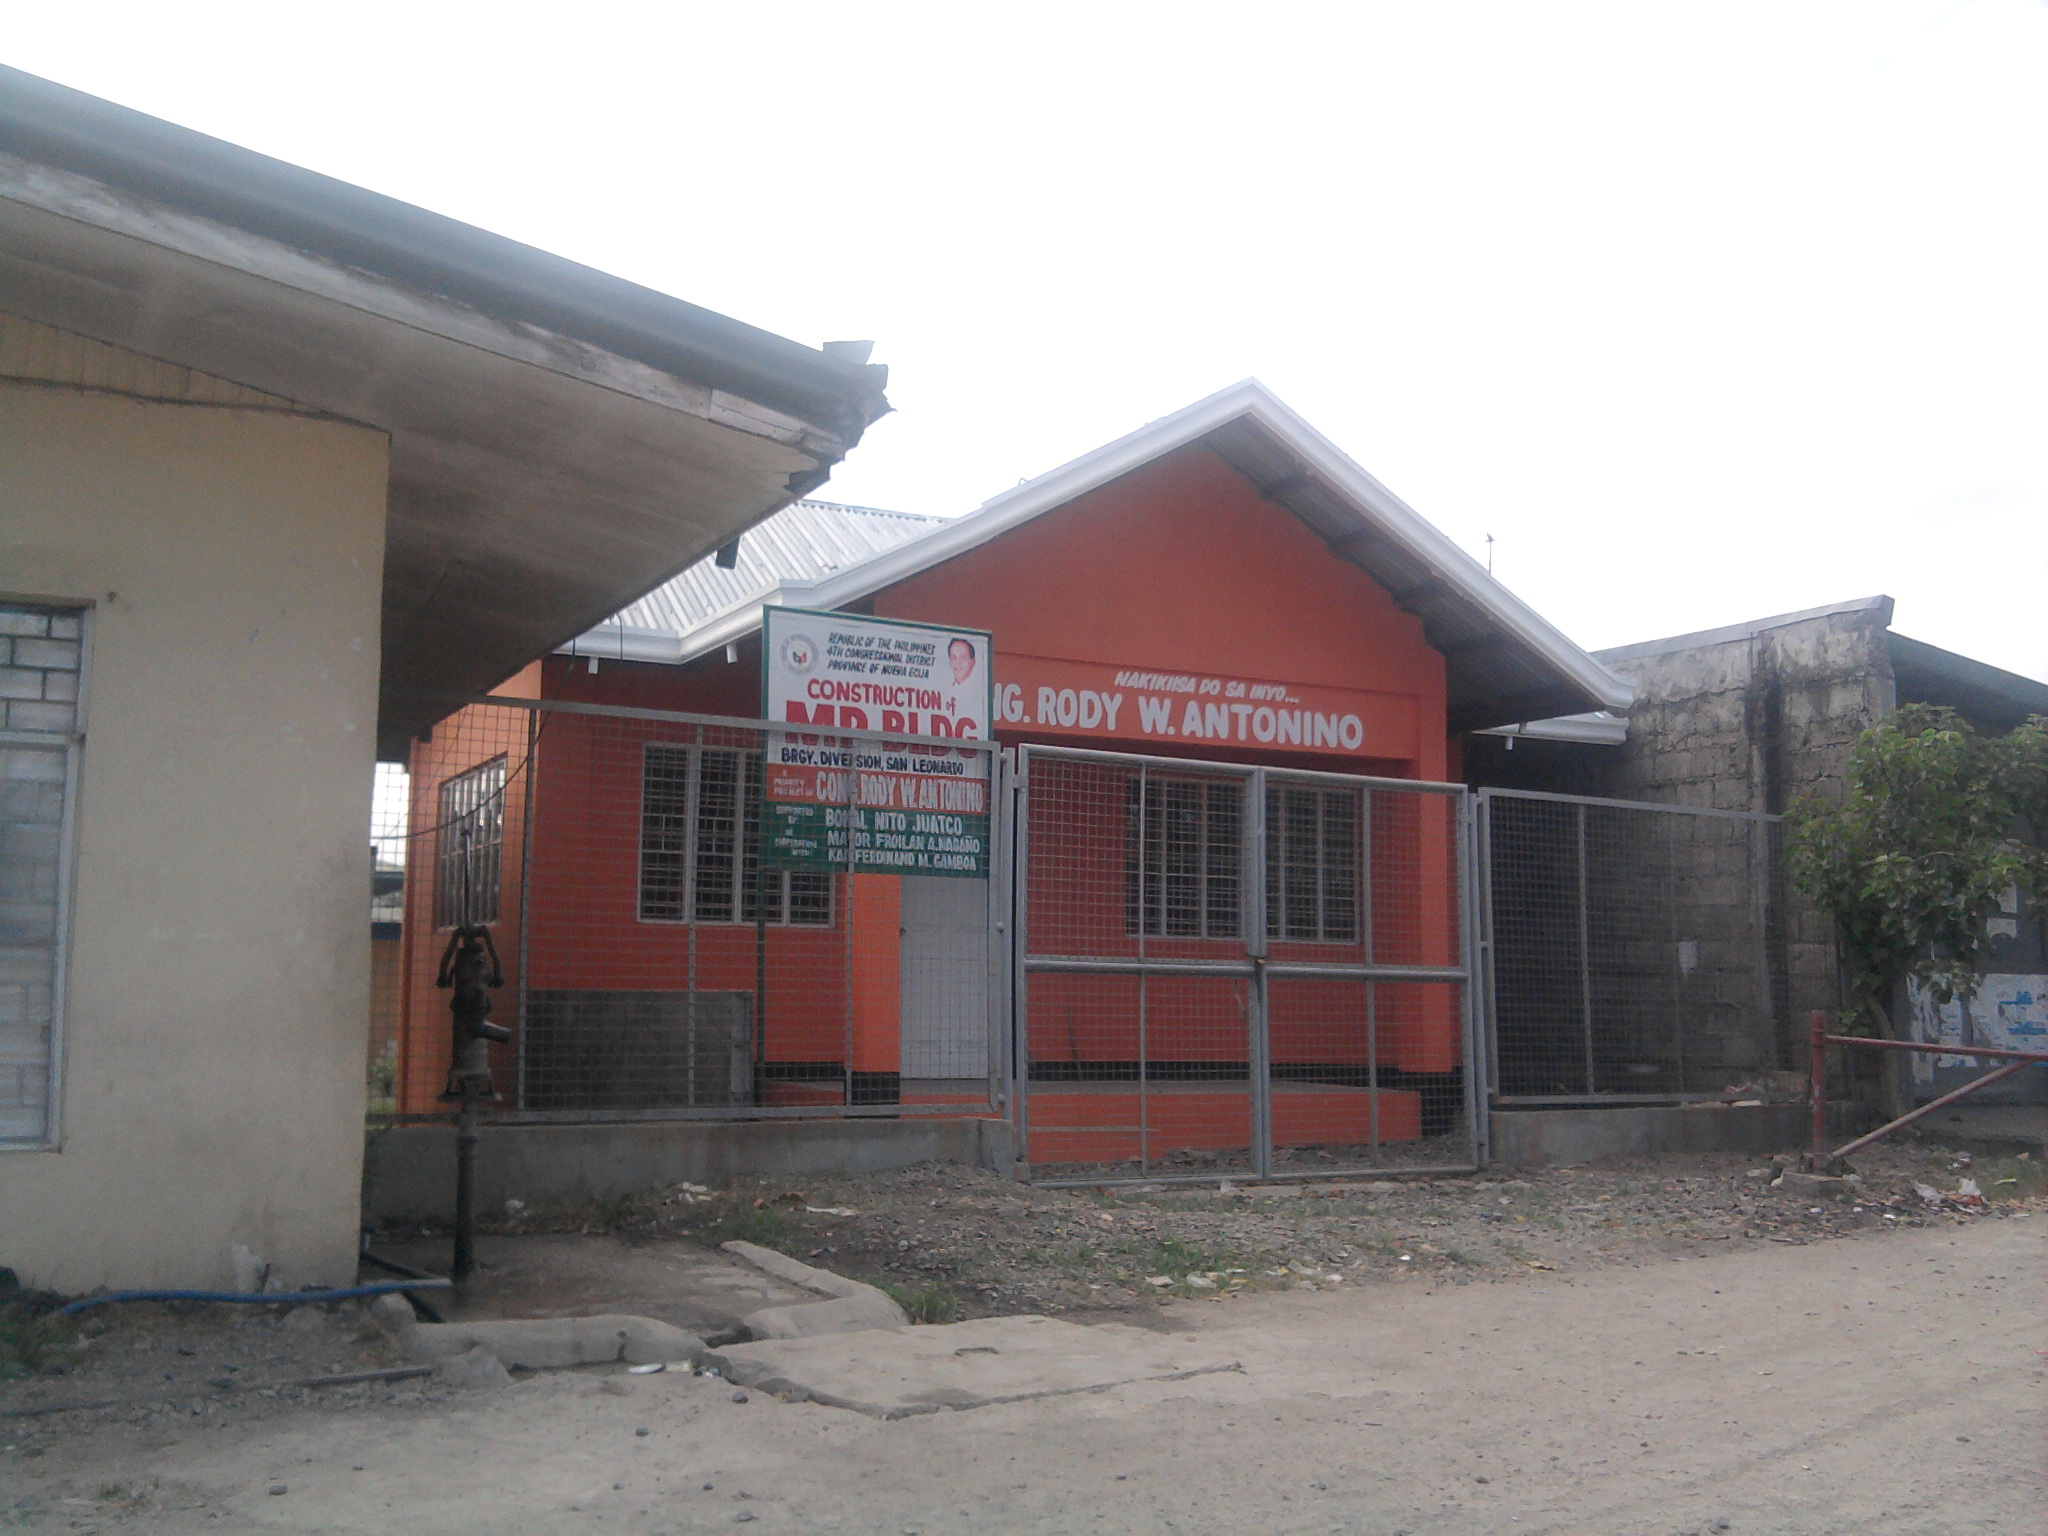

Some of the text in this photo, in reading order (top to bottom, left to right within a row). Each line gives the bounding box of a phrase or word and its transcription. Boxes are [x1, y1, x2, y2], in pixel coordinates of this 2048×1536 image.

[828, 632, 936, 655] REPUBLIC OF THE PHILIPPINES
[827, 646, 843, 657] 4TH
[906, 654, 936, 667] DISTRICT
[827, 659, 930, 678] PROVINCE OF NUEVA ECIJA
[807, 678, 957, 717] CONSTRUCTION of
[1199, 679, 1220, 696] PO
[1225, 681, 1244, 698] SA
[1037, 686, 1122, 731] RODY
[1181, 701, 1363, 750] ANTONINO
[781, 747, 964, 775] BRGY. DIVESION, SAN LEONARDO
[875, 811, 907, 831] NITO
[912, 814, 963, 836] JUATCO
[827, 830, 871, 848] MAOR
[876, 833, 925, 851] FROILAN
[855, 849, 915, 867] FERDINAND
[934, 853, 977, 870] GAMBOA
